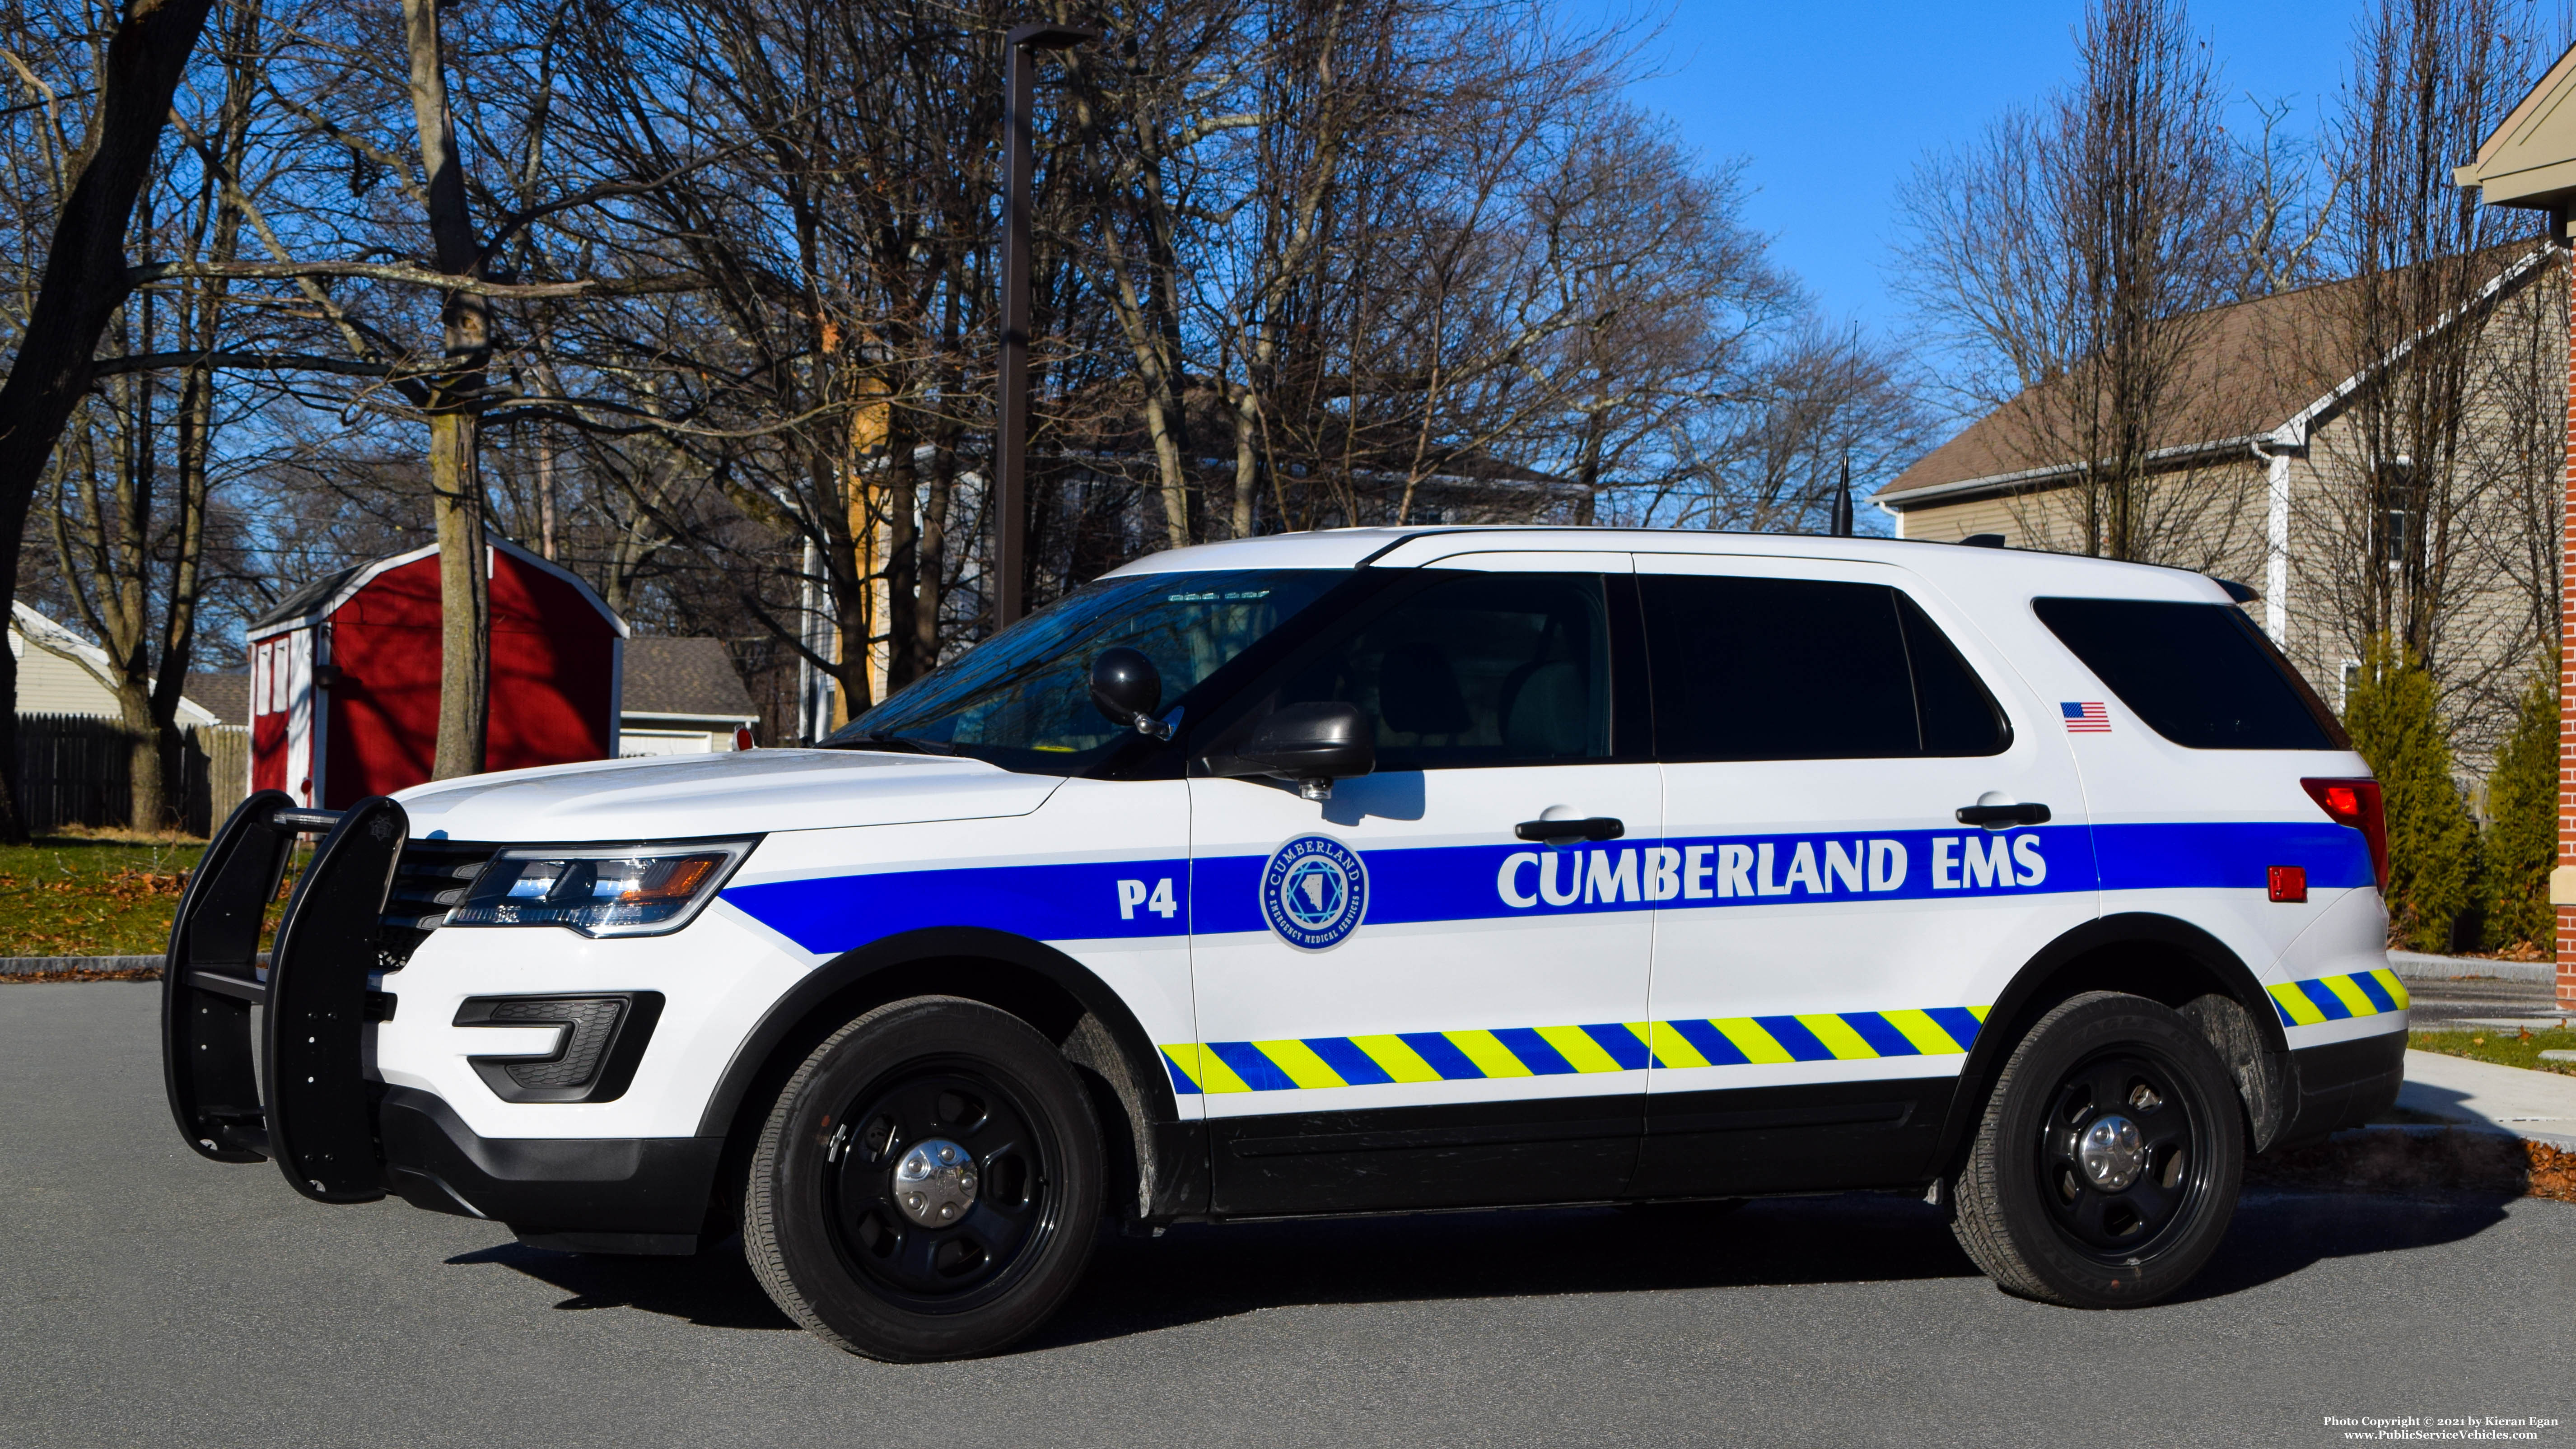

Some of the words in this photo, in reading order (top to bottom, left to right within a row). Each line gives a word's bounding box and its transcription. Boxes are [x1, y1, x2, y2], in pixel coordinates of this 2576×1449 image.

[1270, 841, 1359, 885] CUMBERLAND
[1497, 839, 1907, 908] CUMBERLAND
[1932, 834, 2047, 888] EMS
[1117, 878, 1177, 919] P4
[1269, 899, 1302, 940] EMERGENCY
[1305, 930, 1338, 943] MEDICAL
[1339, 896, 1359, 932] SERVICES
